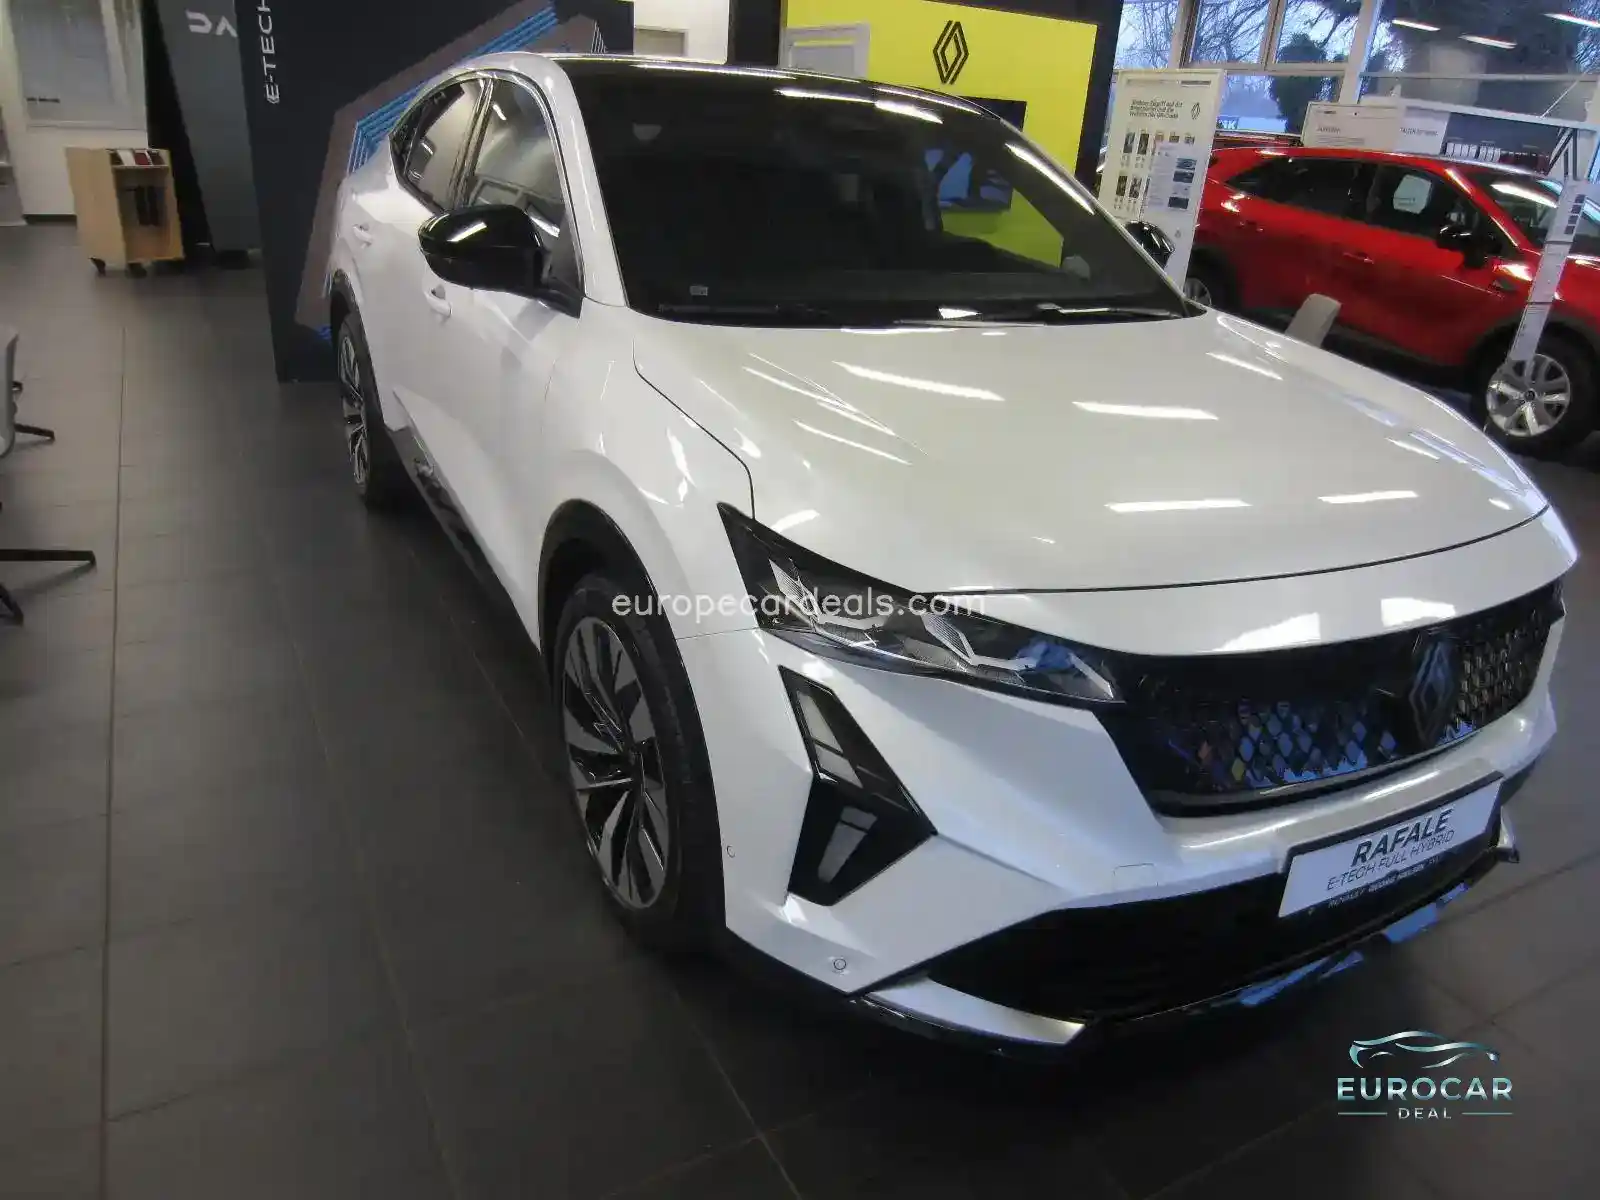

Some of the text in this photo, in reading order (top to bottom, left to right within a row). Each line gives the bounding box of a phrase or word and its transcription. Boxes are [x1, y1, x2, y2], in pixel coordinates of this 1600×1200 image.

[1326, 860, 1377, 891] E-TECH
[1378, 848, 1407, 872] FULL
[1410, 829, 1456, 859] HYBRID
[1351, 808, 1453, 866] RAFALE
